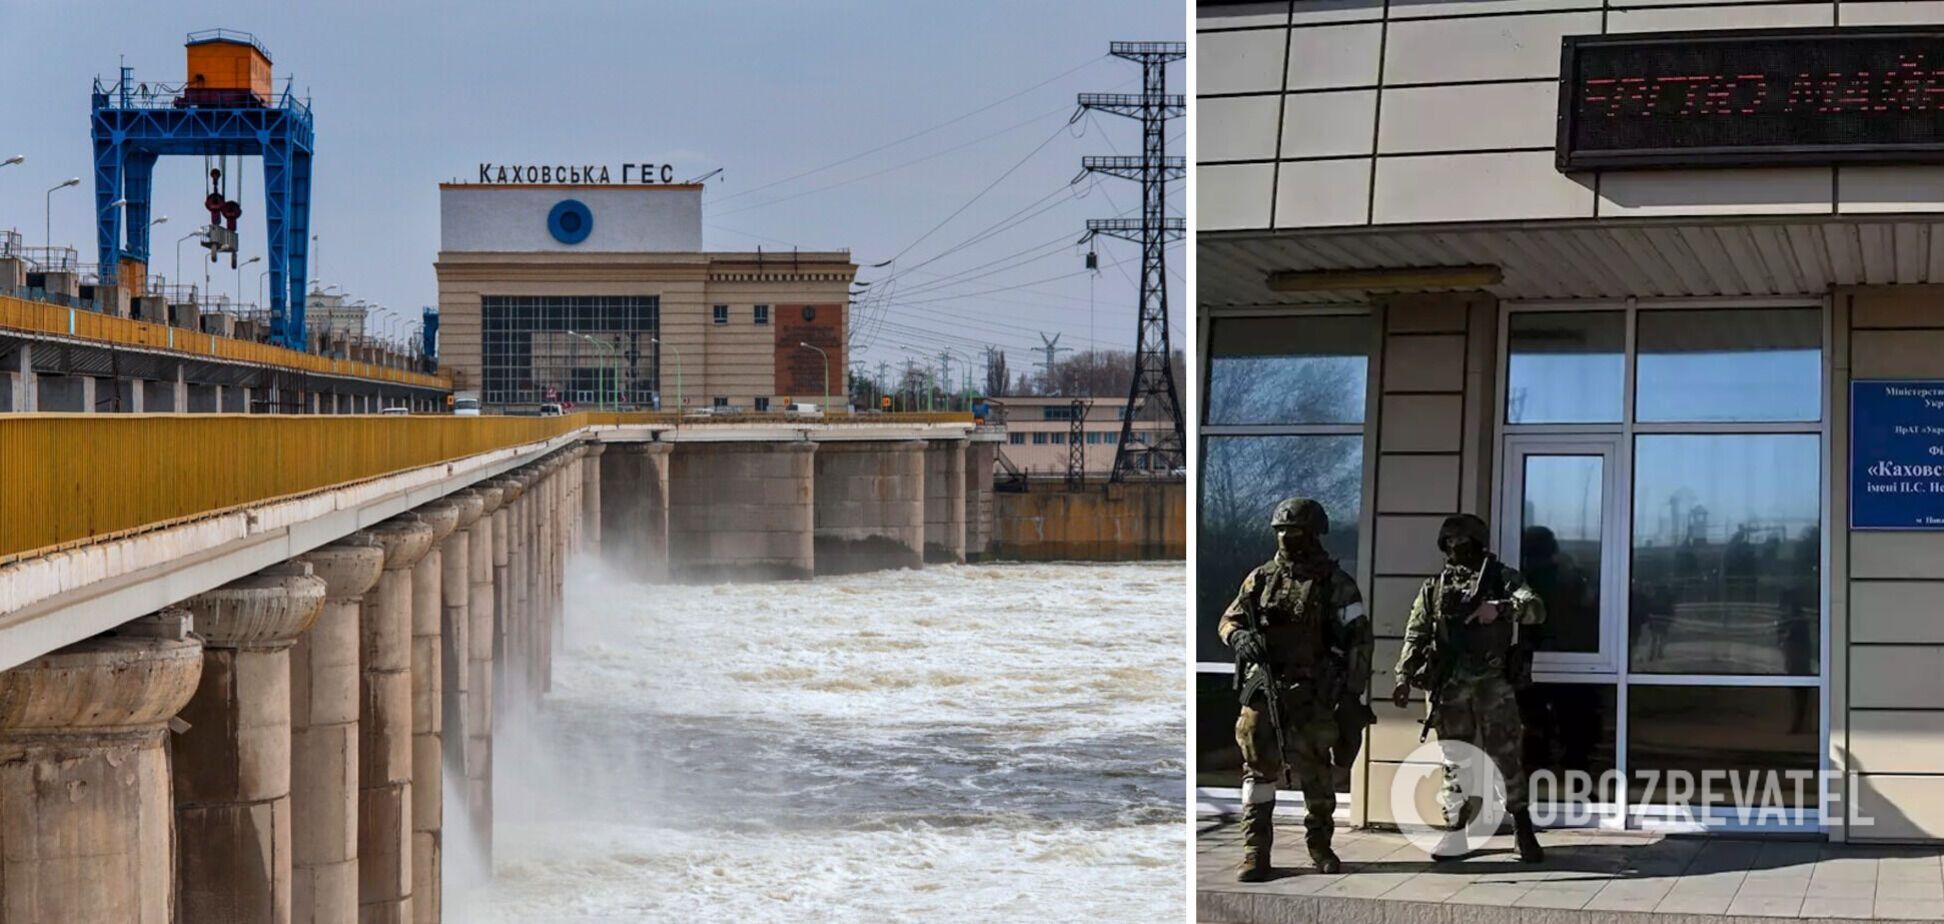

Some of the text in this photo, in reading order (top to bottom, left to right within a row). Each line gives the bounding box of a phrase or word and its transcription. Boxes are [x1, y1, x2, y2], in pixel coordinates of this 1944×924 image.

[479, 163, 673, 184] КАХОВСЬКА ГЕС
[1928, 445, 1944, 456] Фі
[1867, 460, 1944, 477] «Каховс
[1900, 482, 1926, 493] П.С.
